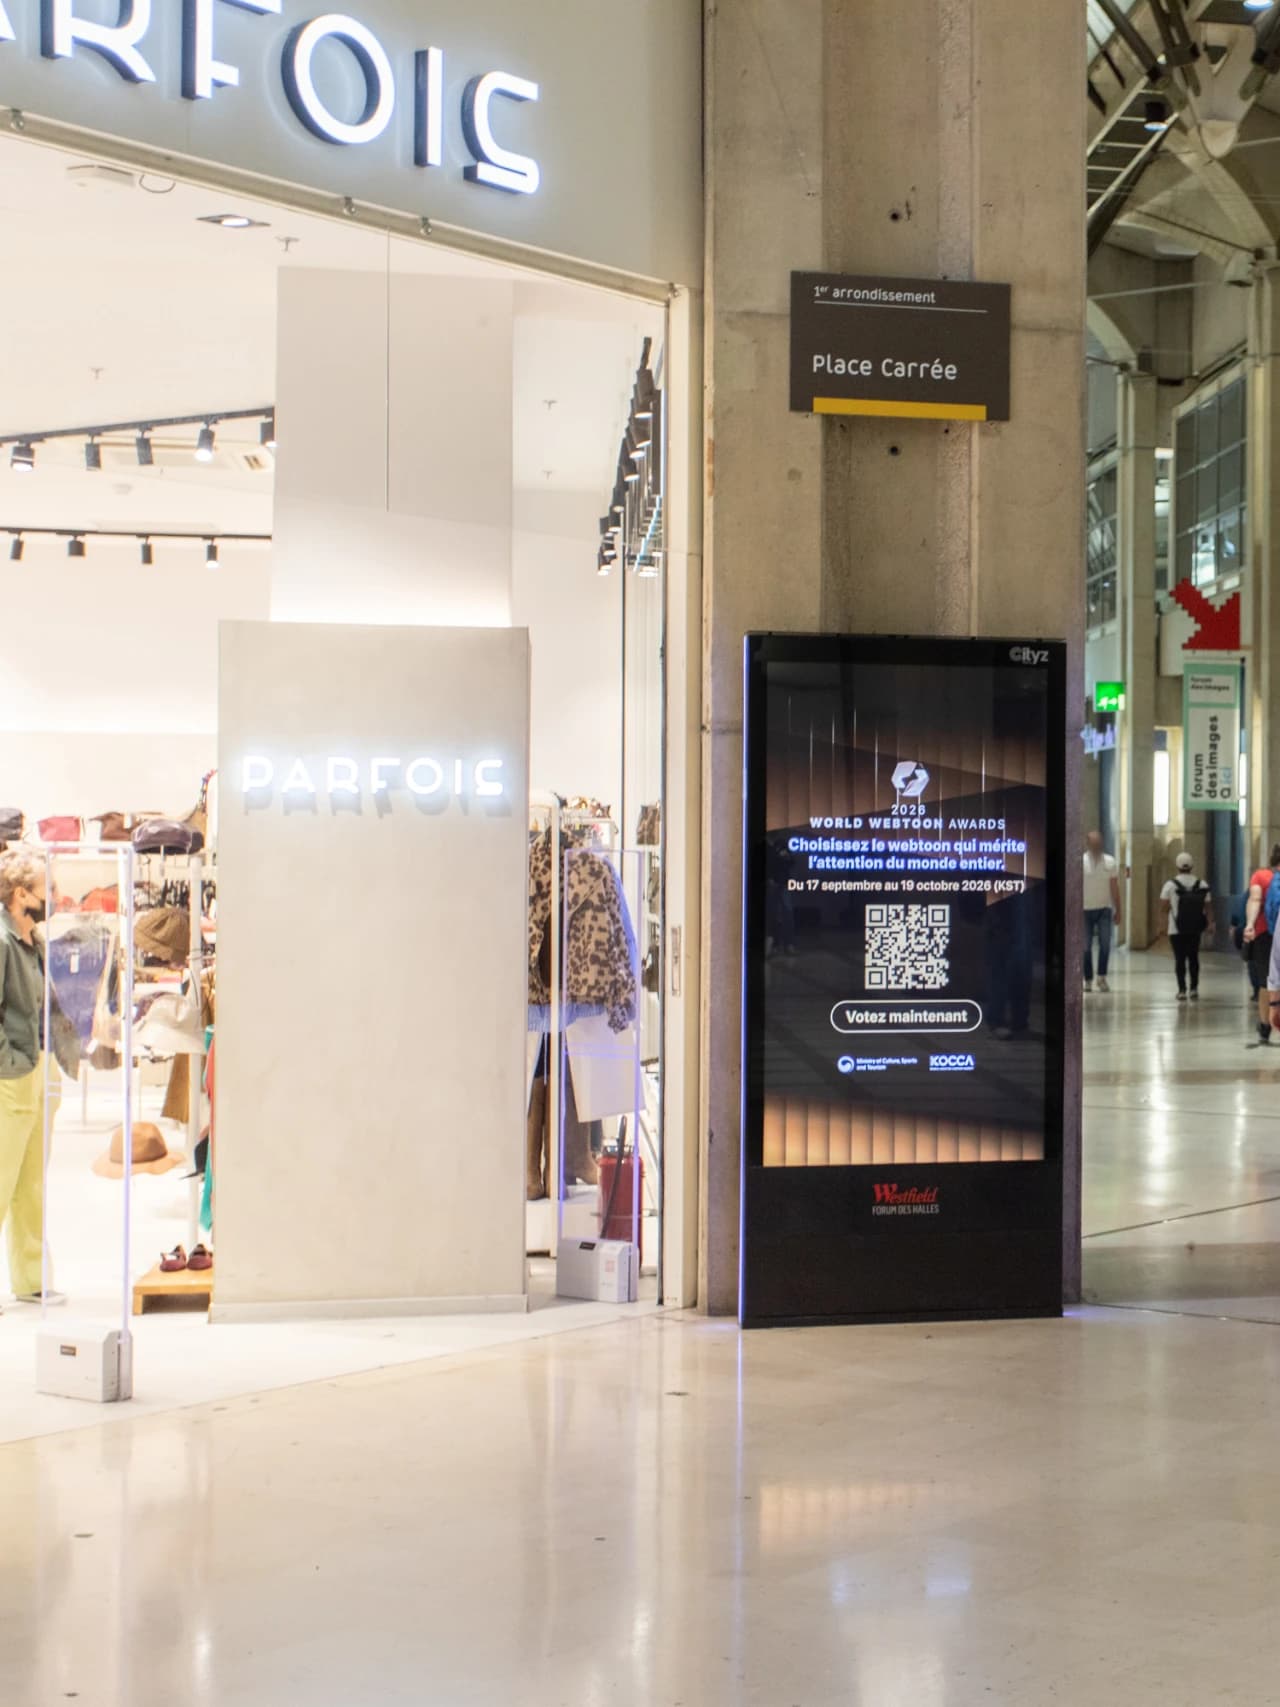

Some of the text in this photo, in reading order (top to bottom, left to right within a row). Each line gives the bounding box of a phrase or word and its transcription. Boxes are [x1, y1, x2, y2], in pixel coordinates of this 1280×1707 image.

[0, 0, 538, 193] RFOIS
[814, 285, 936, 303] 1er arrondissement
[812, 354, 958, 380] Place Carrée
[1206, 716, 1220, 799] des images
[241, 755, 504, 796] PARFOIS
[1191, 753, 1203, 798] forum
[891, 804, 926, 816] 2026
[809, 817, 1006, 830] WORLD WEBTOON AWARDS
[788, 837, 1026, 857] Choisissez le webtoon qui mérite
[808, 856, 1006, 871] l'attention du monde entier.
[788, 880, 1025, 894] Du 17 septembre au 19 octobre 2026 (KST)
[846, 1009, 968, 1024] Votez maintenant
[929, 1055, 975, 1067] KOCCA
[872, 1204, 940, 1217] FORUM DES HALLES
